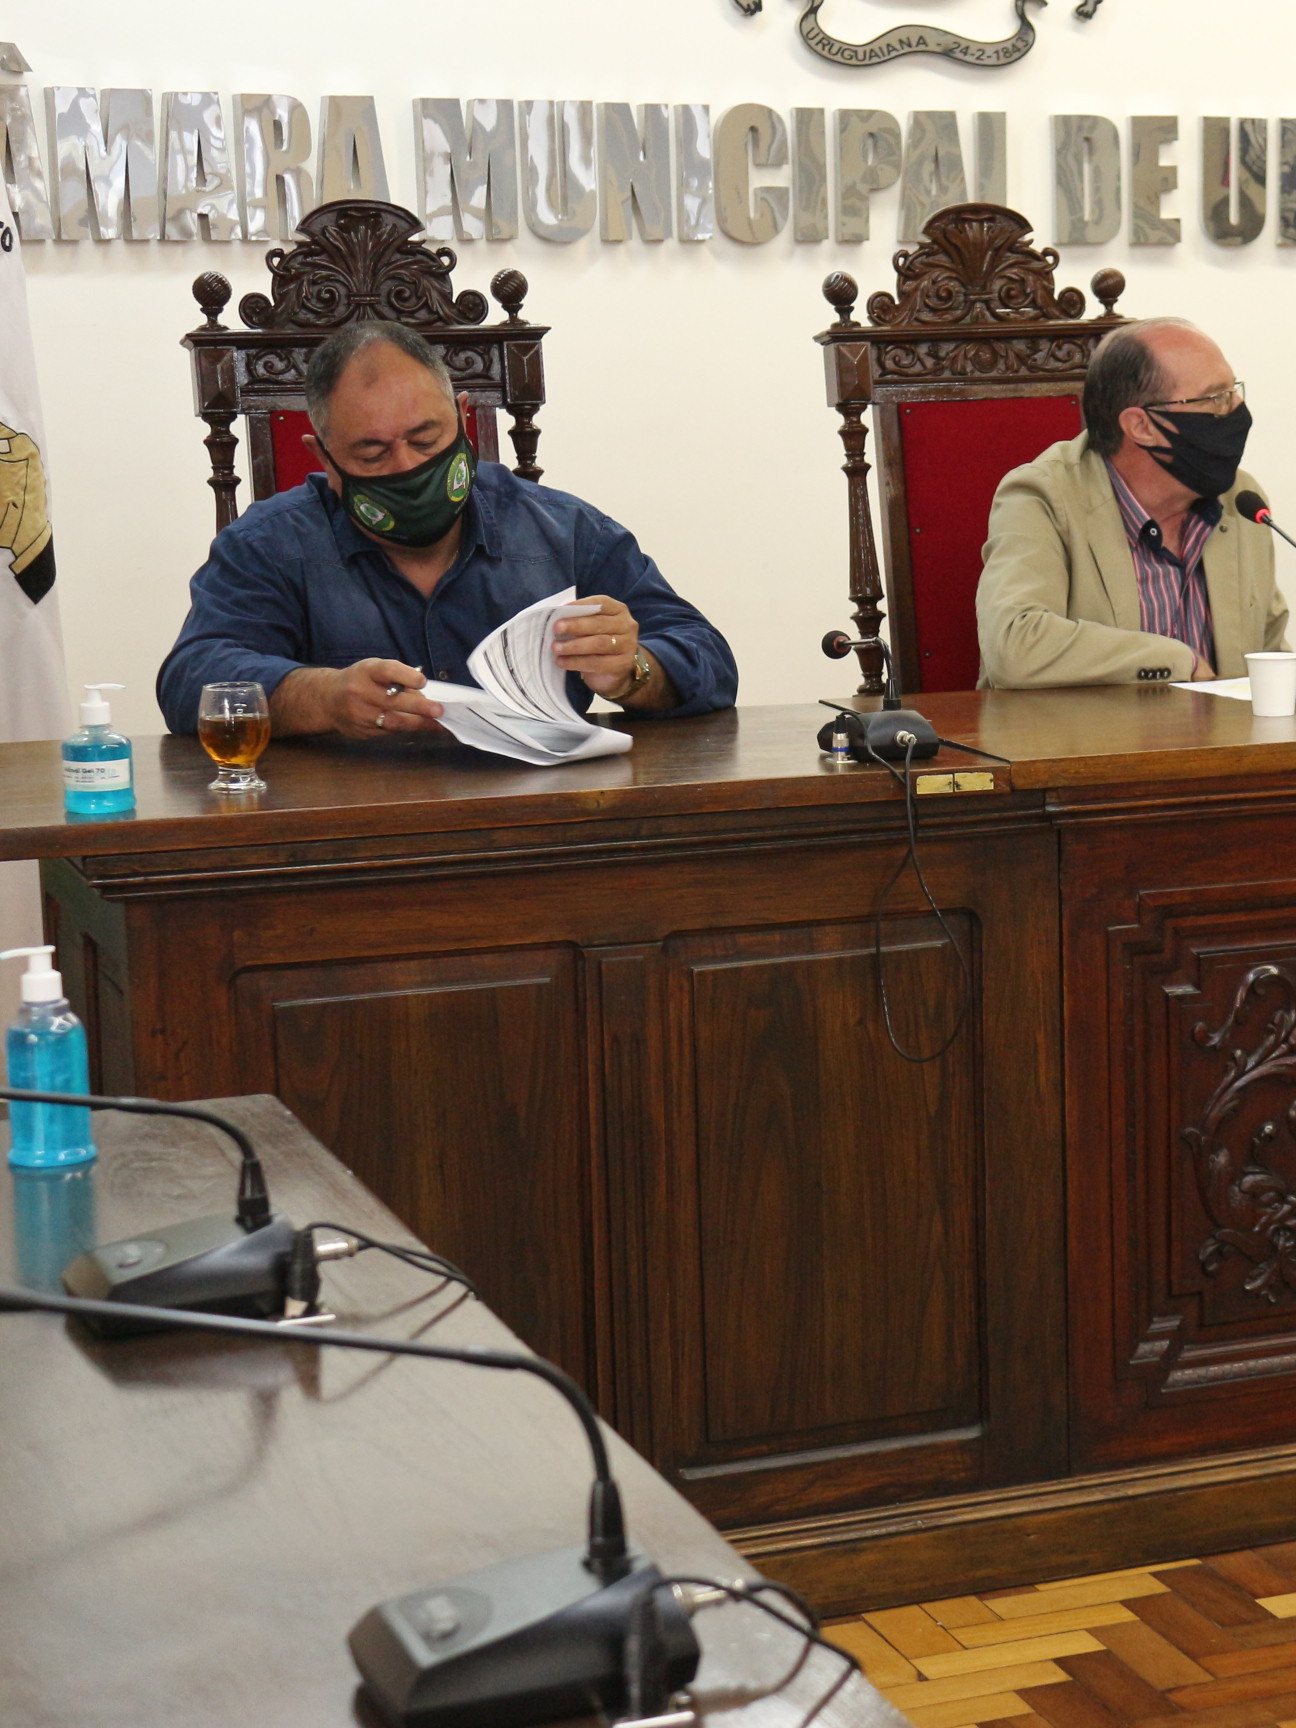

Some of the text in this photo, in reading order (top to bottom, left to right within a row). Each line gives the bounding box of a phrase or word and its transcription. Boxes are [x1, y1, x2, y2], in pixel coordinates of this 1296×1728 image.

[805, 27, 928, 62] URUGUAIANA
[950, 36, 1029, 62] 24-2-1843
[1049, 114, 1181, 246] DE
